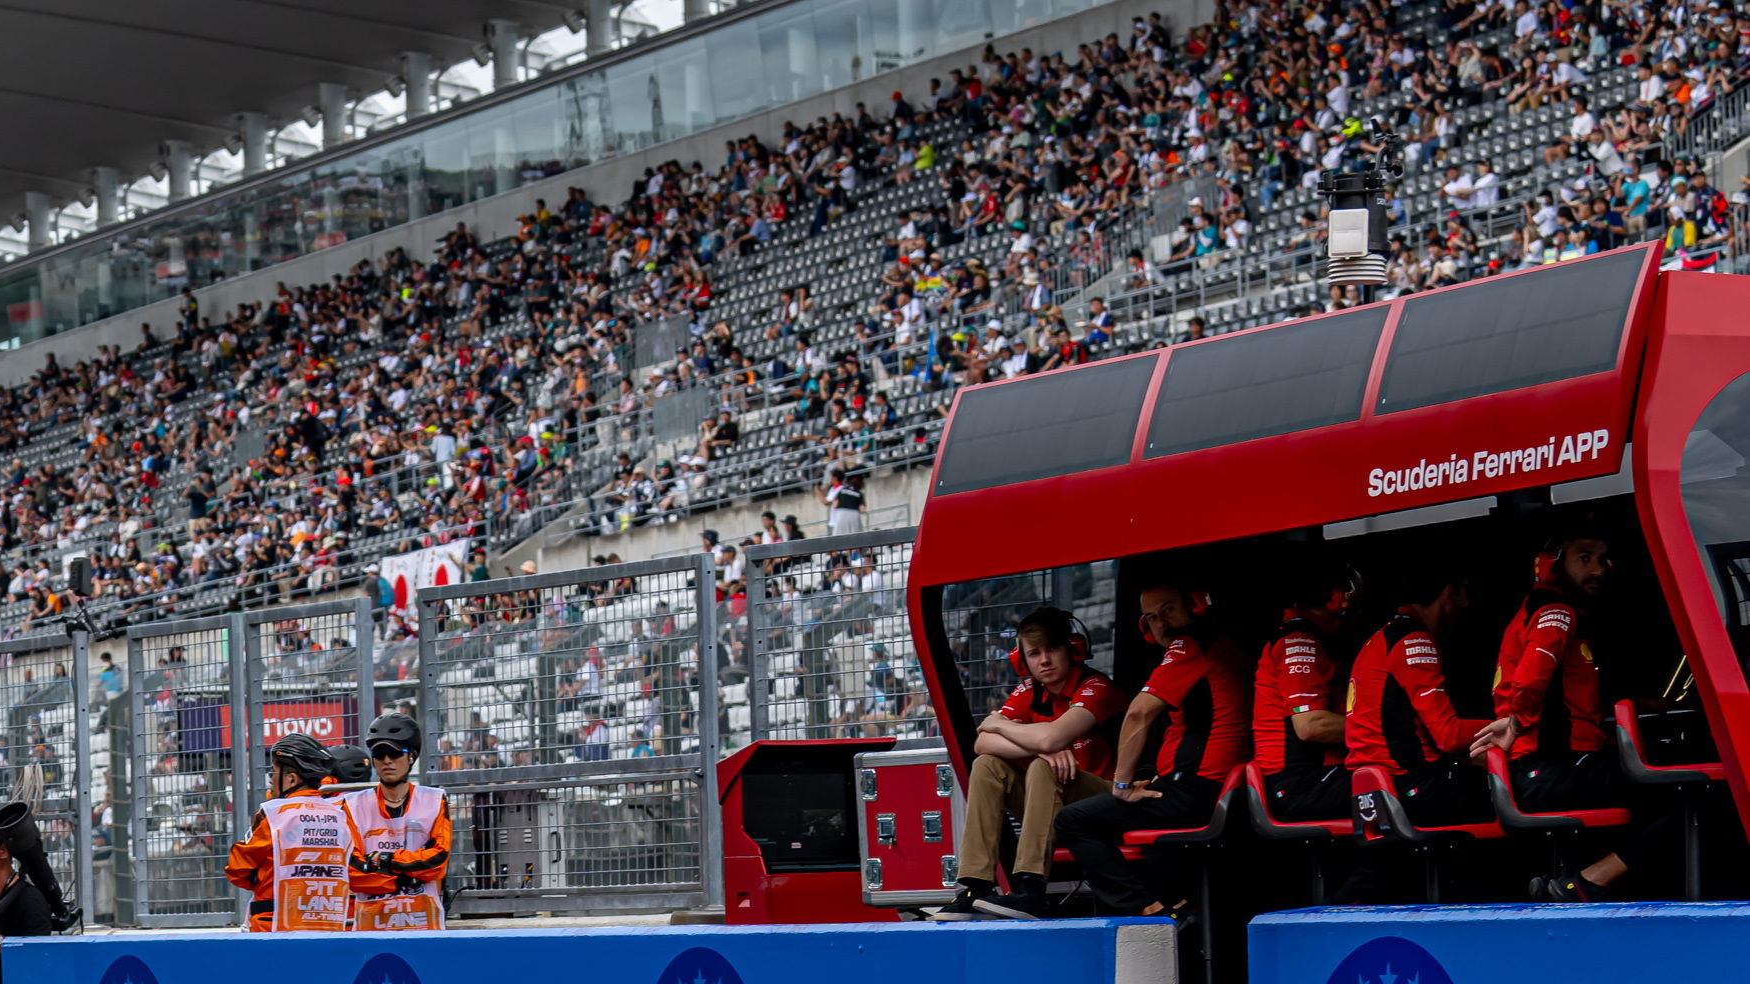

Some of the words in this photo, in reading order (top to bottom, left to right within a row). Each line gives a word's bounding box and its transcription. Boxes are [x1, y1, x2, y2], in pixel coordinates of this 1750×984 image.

[1367, 453, 1469, 497] Scuderia
[1472, 436, 1555, 480] Ferrari
[1557, 429, 1610, 466] APP
[1285, 646, 1316, 655] MAHLE
[1406, 646, 1437, 655] MAHLE
[1289, 665, 1311, 674] ZCG
[263, 717, 333, 737] novo
[299, 814, 338, 823] 0041-JPN
[303, 828, 339, 837] PIT/GRID
[301, 837, 340, 847] MARSHAL
[377, 841, 405, 850] 0039-
[304, 880, 338, 895] PIT
[297, 896, 344, 911] LANE
[383, 898, 415, 914] PIT
[374, 911, 428, 929] LANE
